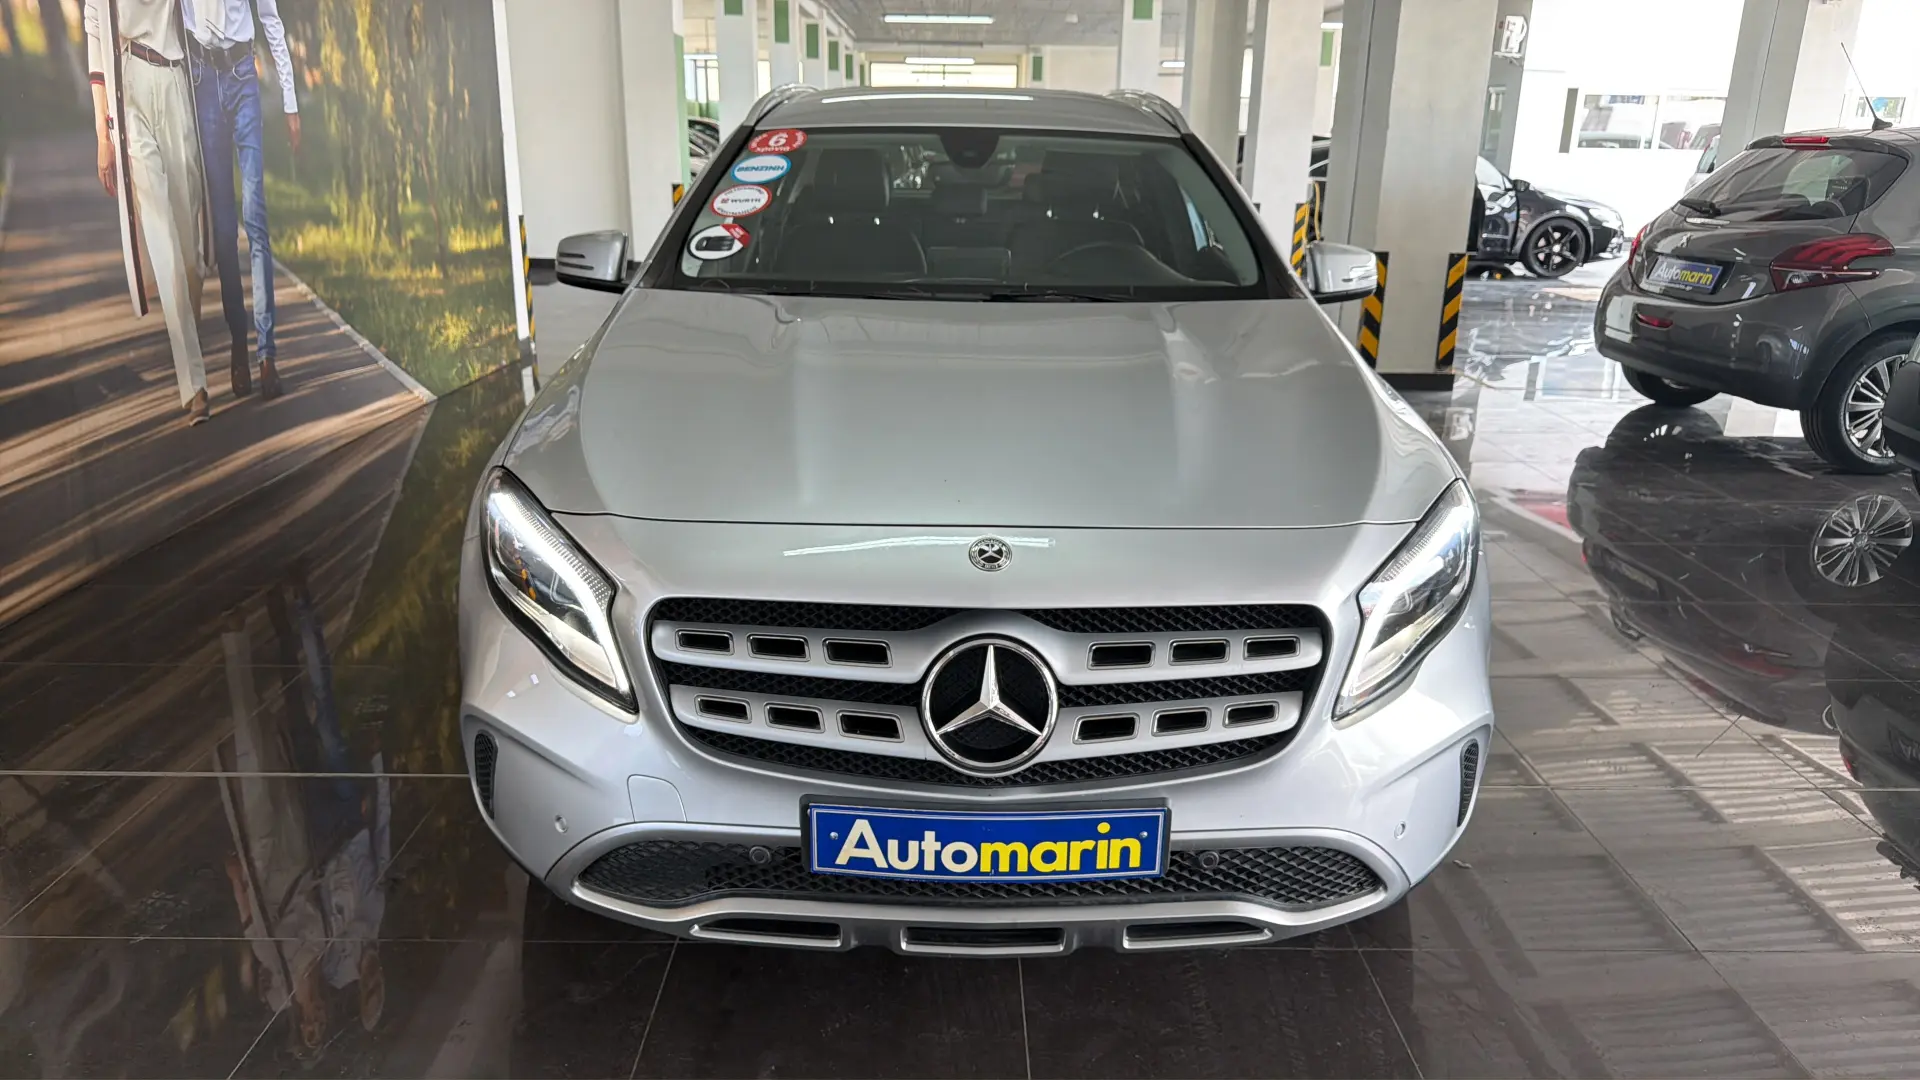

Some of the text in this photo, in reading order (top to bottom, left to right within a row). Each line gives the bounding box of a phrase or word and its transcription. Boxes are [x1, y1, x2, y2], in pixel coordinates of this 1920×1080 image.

[768, 132, 788, 147] 6
[1654, 262, 1713, 286] Automarin
[835, 819, 1141, 873] Automarin
